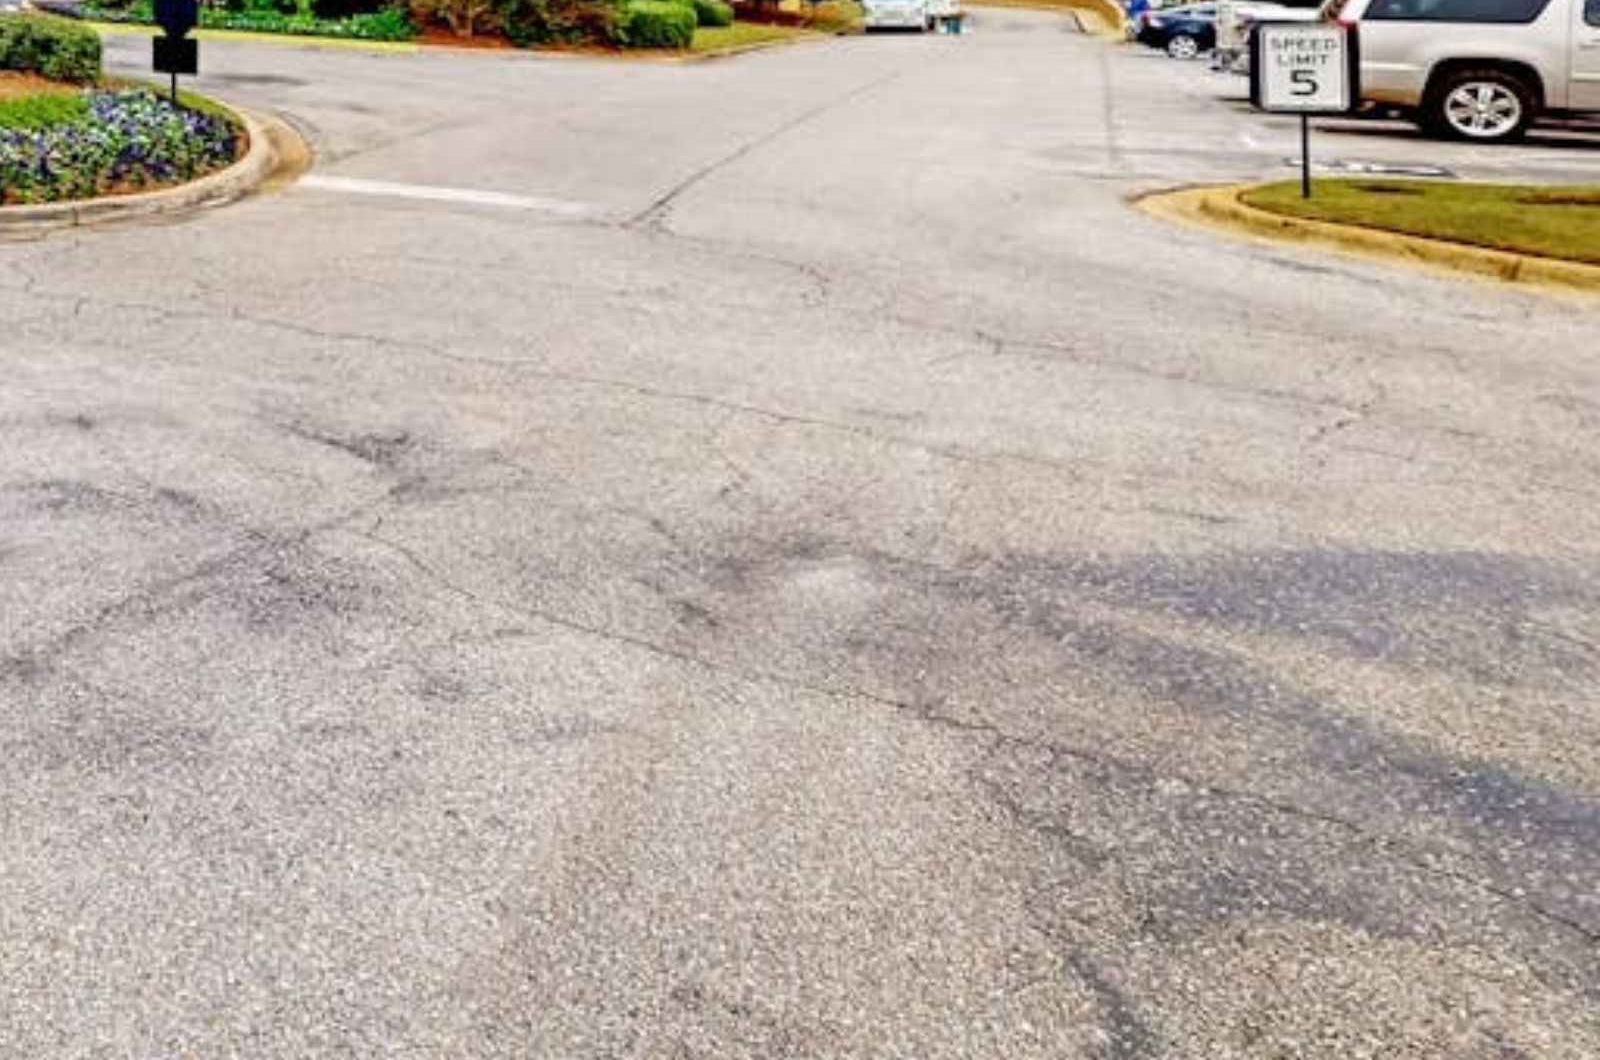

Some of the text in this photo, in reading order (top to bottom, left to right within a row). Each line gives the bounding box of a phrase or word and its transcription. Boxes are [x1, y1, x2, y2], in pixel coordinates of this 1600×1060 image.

[1271, 38, 1338, 50] SPEED
[1277, 53, 1329, 66] LIMIT
[1290, 69, 1319, 96] 5
